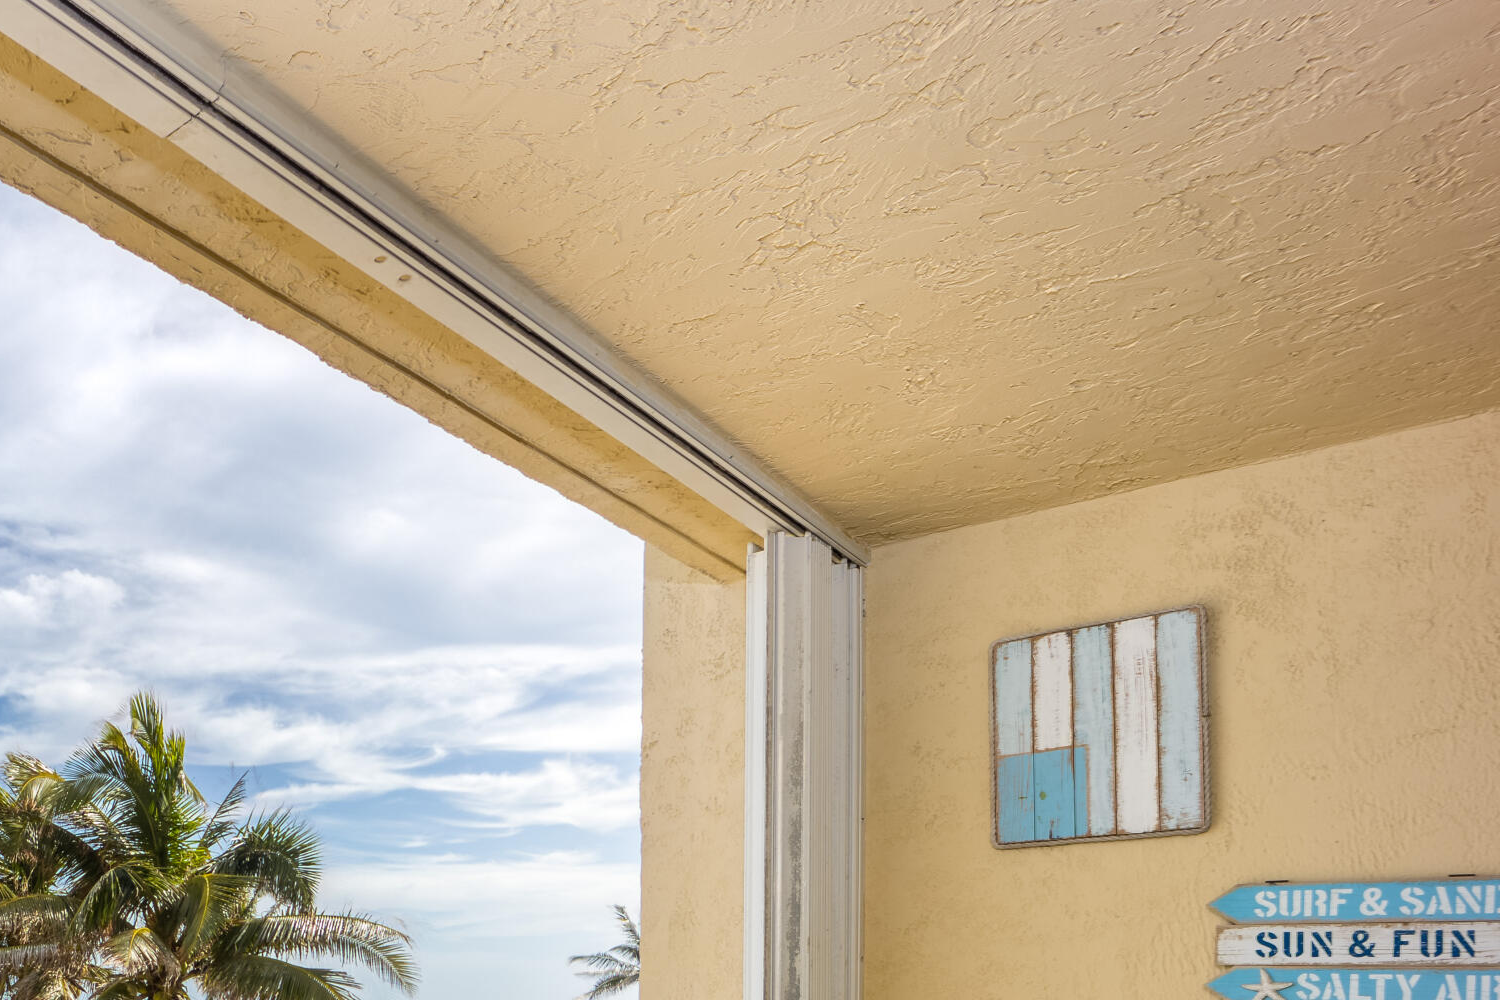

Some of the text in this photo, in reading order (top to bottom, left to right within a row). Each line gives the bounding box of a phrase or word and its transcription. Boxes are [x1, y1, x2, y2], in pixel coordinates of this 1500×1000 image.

[1253, 889, 1353, 918] SURF
[1360, 887, 1388, 916] &
[1255, 930, 1476, 958] SUN & FUN
